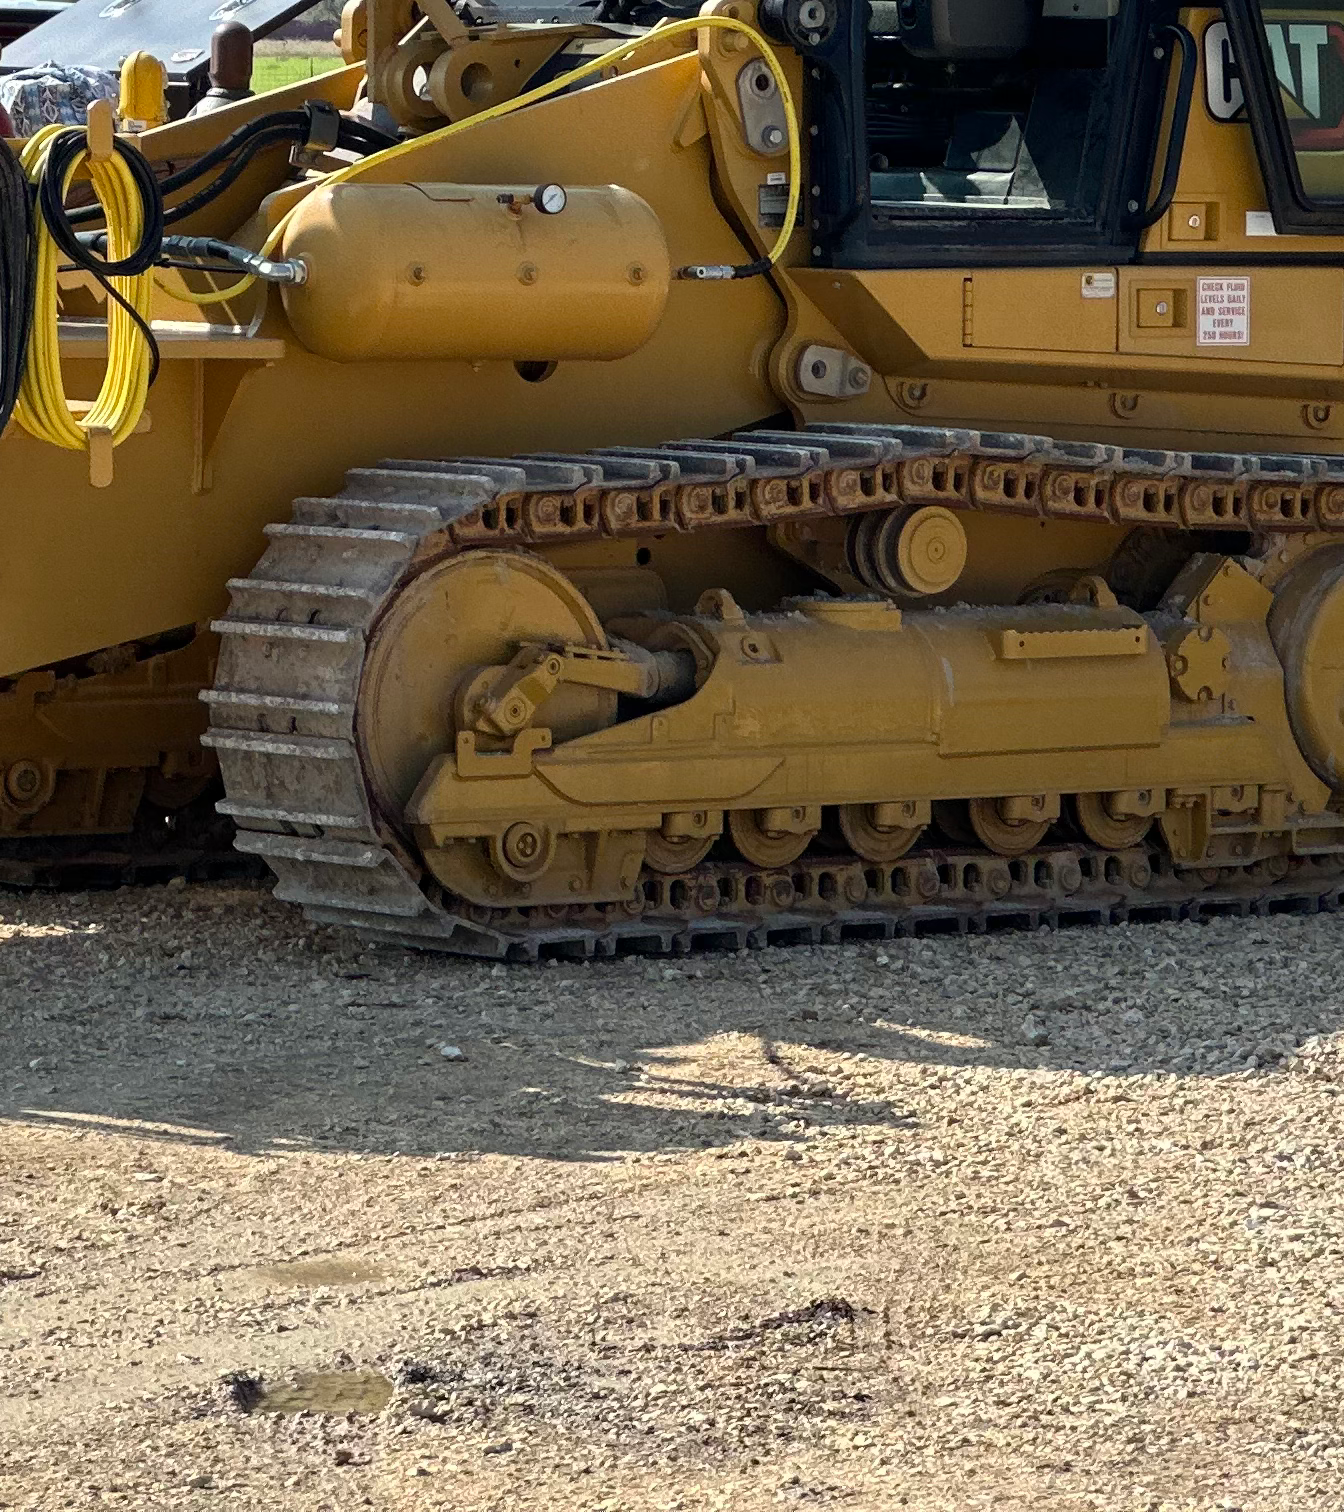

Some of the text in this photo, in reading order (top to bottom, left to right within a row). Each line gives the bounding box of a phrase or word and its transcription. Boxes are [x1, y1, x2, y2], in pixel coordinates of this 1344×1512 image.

[1201, 282, 1224, 292] CHECK
[1200, 294, 1246, 304] LEVELS DAILY
[1201, 306, 1246, 316] AND SERVICE
[1212, 318, 1234, 328] EVERY
